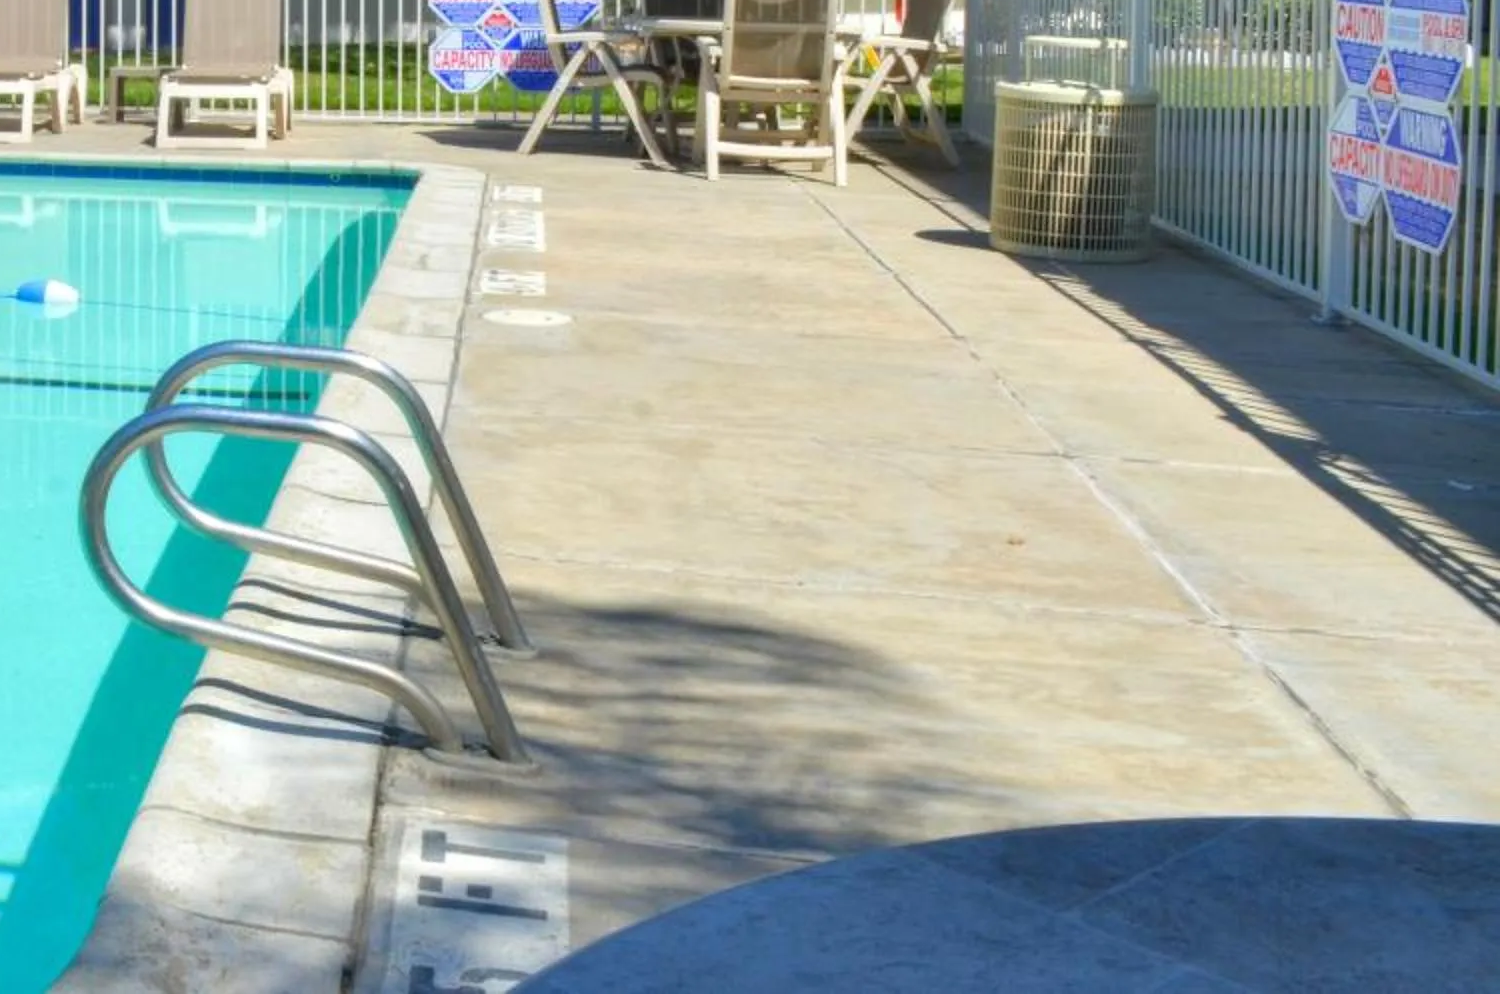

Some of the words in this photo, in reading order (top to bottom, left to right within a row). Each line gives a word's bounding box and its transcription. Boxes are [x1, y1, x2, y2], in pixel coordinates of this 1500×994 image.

[1336, 4, 1385, 43] CAUTION
[433, 51, 496, 70] CAPACITY
[1399, 108, 1447, 157] WARNING
[1329, 134, 1382, 182] CAPACITY
